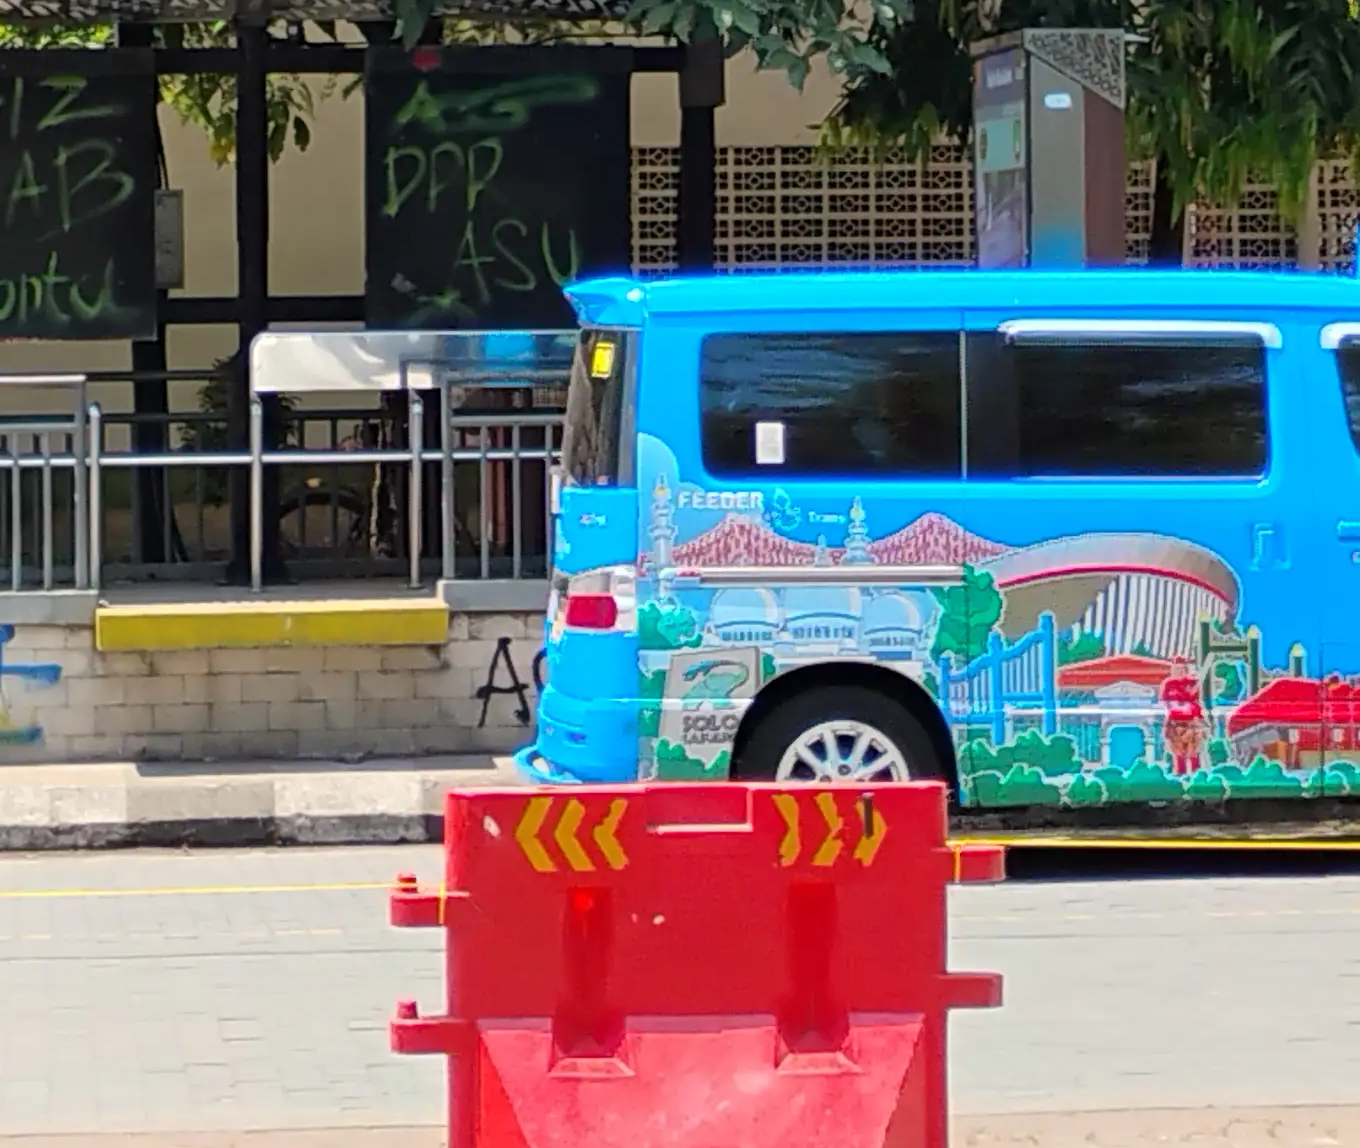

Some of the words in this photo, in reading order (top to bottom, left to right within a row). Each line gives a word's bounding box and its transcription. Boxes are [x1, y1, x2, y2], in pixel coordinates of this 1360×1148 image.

[452, 218, 580, 304] ASU
[677, 491, 764, 510] FEEDER
[682, 714, 740, 732] SOLO
